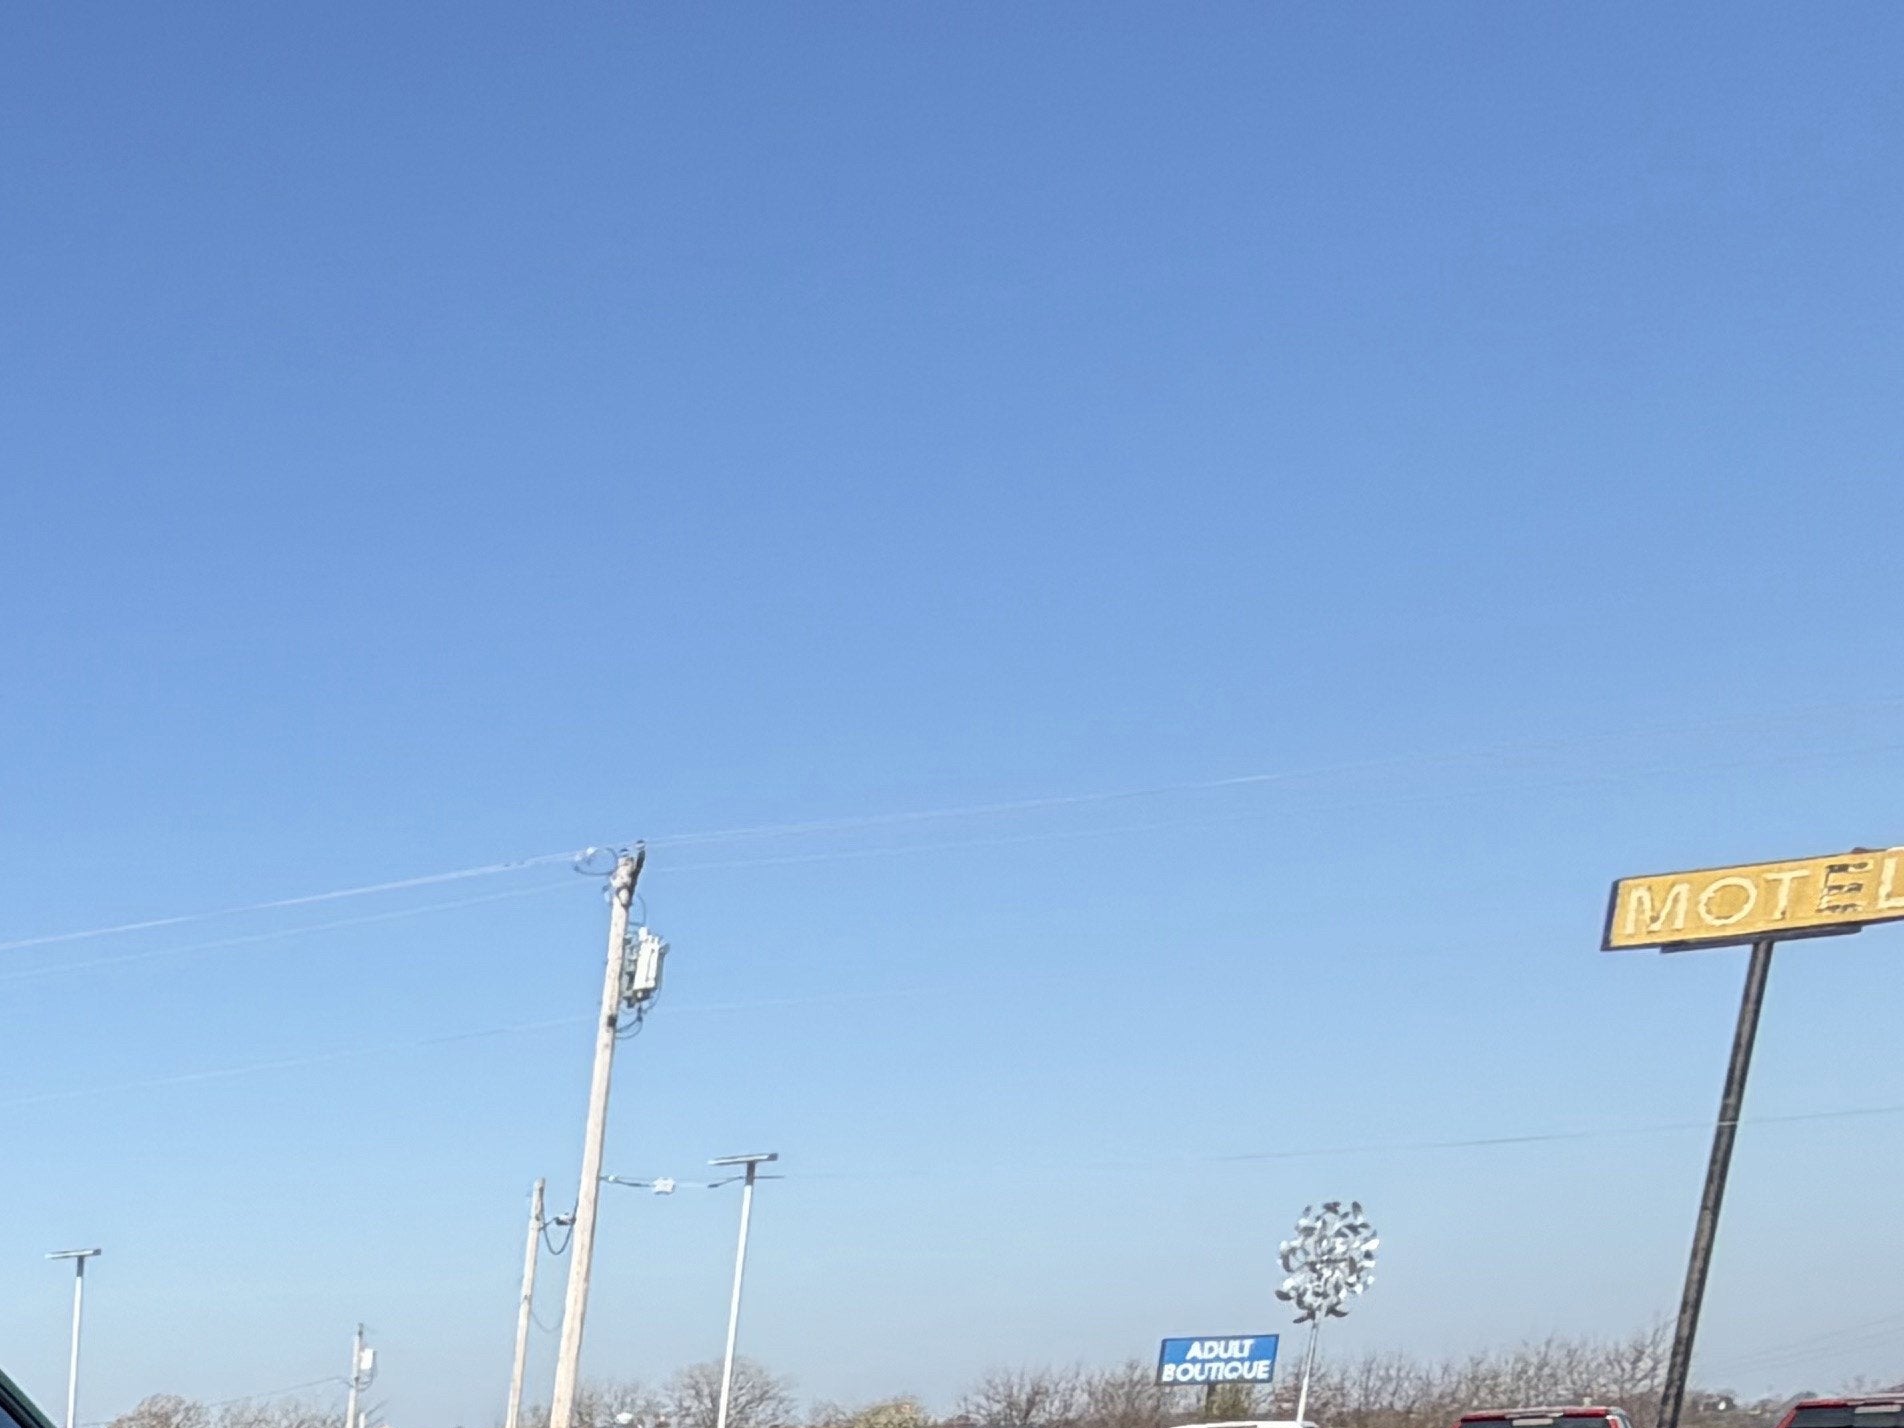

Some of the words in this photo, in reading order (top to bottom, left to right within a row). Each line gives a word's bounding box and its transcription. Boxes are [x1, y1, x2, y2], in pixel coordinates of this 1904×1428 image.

[1622, 857, 1904, 935] MOTEL
[1185, 1338, 1255, 1360] ADULT
[1162, 1359, 1273, 1382] BOUTIQUE
